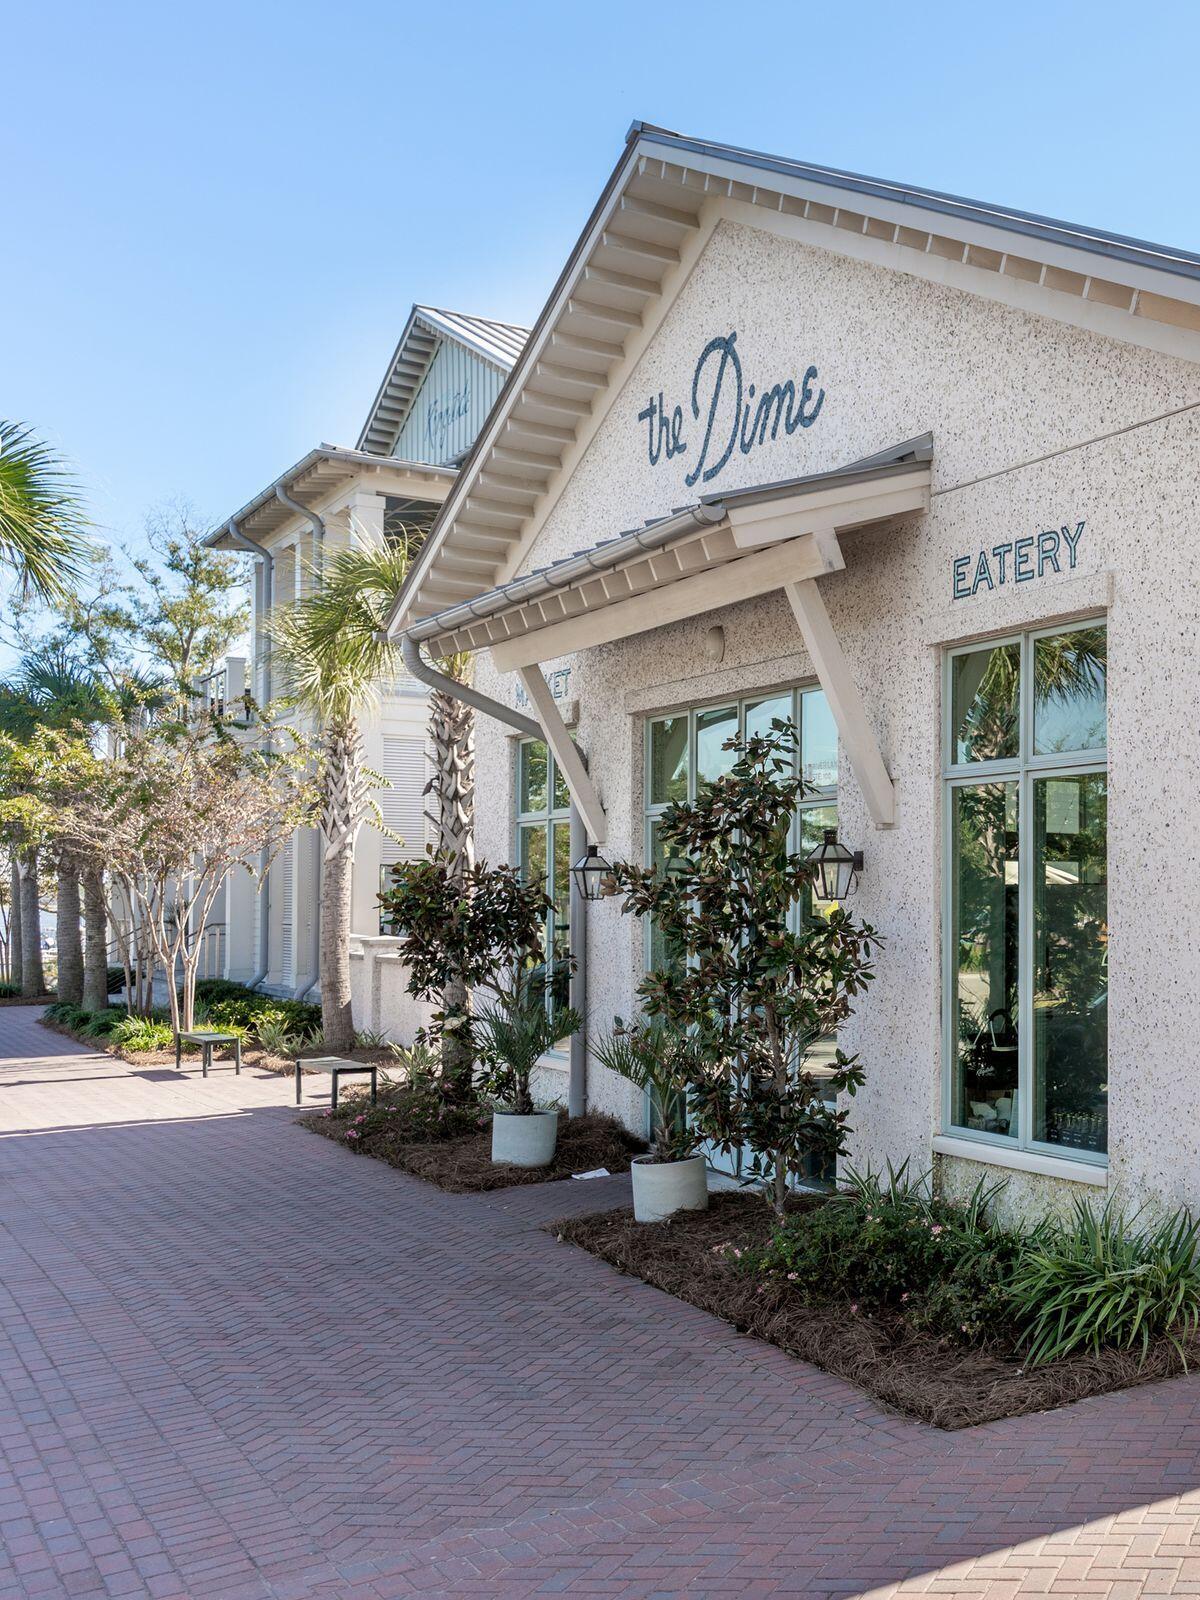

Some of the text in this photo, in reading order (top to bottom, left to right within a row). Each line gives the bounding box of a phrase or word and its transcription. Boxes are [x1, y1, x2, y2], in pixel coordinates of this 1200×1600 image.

[638, 330, 826, 488] the Dime
[953, 521, 1086, 600] EATERY
[514, 667, 572, 709] MKET
